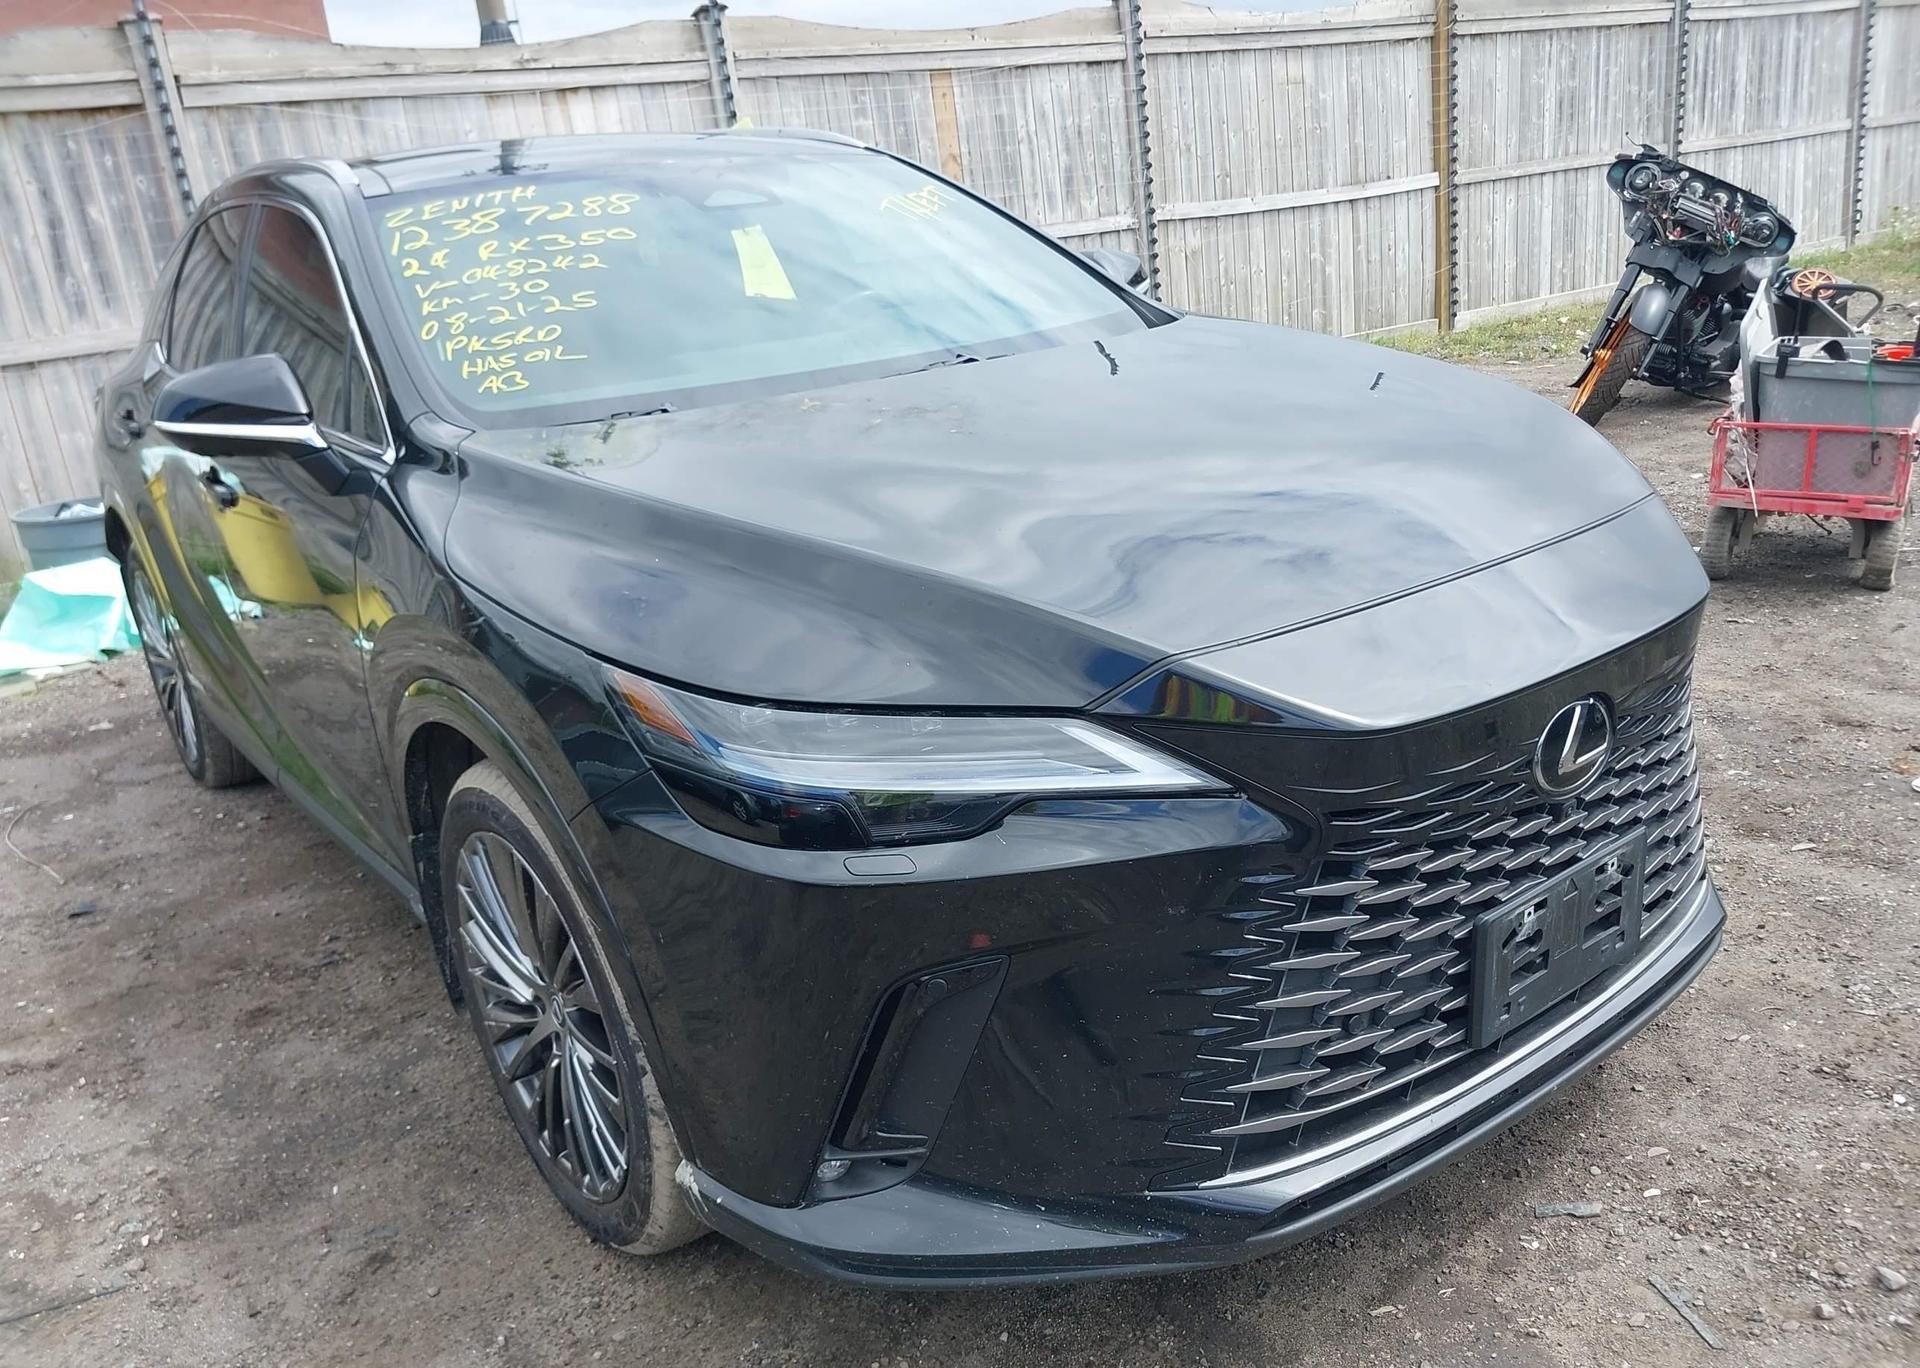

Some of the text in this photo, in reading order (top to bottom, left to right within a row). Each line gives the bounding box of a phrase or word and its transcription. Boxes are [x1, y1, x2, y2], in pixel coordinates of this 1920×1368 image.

[386, 185, 536, 228] ZENITH
[462, 345, 588, 379] HAS OIL
